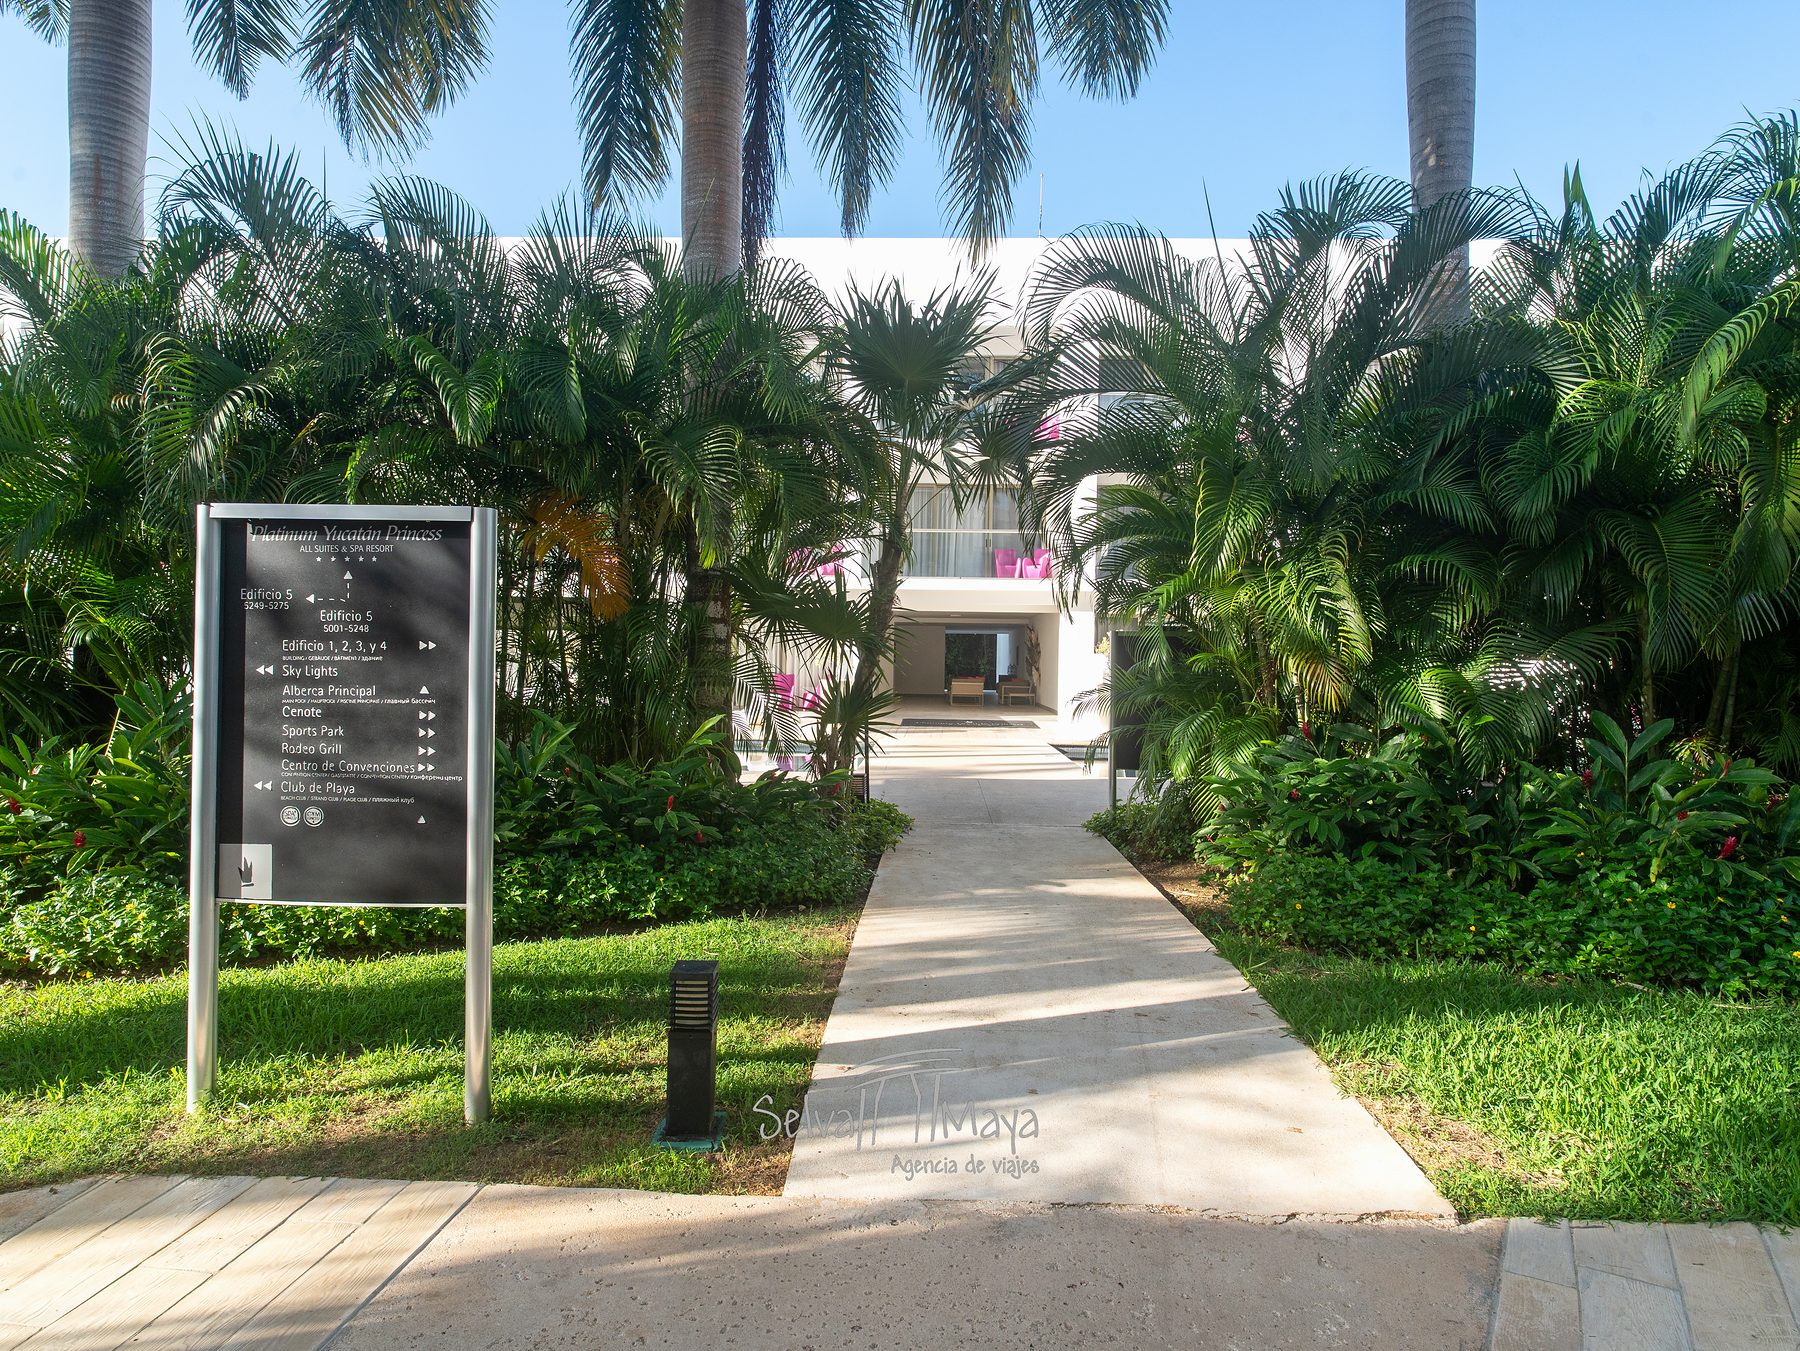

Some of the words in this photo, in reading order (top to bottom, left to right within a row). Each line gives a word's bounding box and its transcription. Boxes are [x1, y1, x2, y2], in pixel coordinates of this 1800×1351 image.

[251, 524, 318, 542] Platinum
[323, 524, 381, 541] Yucatán
[385, 524, 443, 541] Princess
[300, 545, 313, 553] ALL
[314, 545, 339, 553] SUITES
[341, 545, 348, 553] &
[349, 544, 364, 553] SPA
[365, 544, 394, 553] RESORT
[240, 588, 281, 600] Edificio
[286, 588, 293, 600] 5
[243, 601, 290, 610] 5249-5275
[320, 610, 362, 622] Edificio
[366, 610, 373, 622] 5
[323, 624, 370, 633] 5001-5248
[282, 639, 324, 652] Edificio
[329, 640, 338, 653] 1,
[342, 640, 352, 653] 2,
[356, 640, 366, 653] 3,
[369, 642, 377, 654] y
[380, 641, 387, 651] 4
[282, 664, 302, 679] Sky
[305, 665, 338, 679] Lights
[282, 685, 324, 697] Alberca
[328, 684, 376, 698] Principal
[282, 705, 322, 718] Cenote
[282, 725, 317, 738] Sports
[321, 725, 344, 737] Park
[281, 743, 315, 754] Rodeo
[319, 743, 342, 754] Grill
[281, 759, 318, 771] Centro
[322, 760, 335, 772] de
[339, 760, 415, 774] Convenciones
[281, 781, 305, 793] Club
[309, 782, 322, 793] de
[326, 782, 355, 796] Playa
